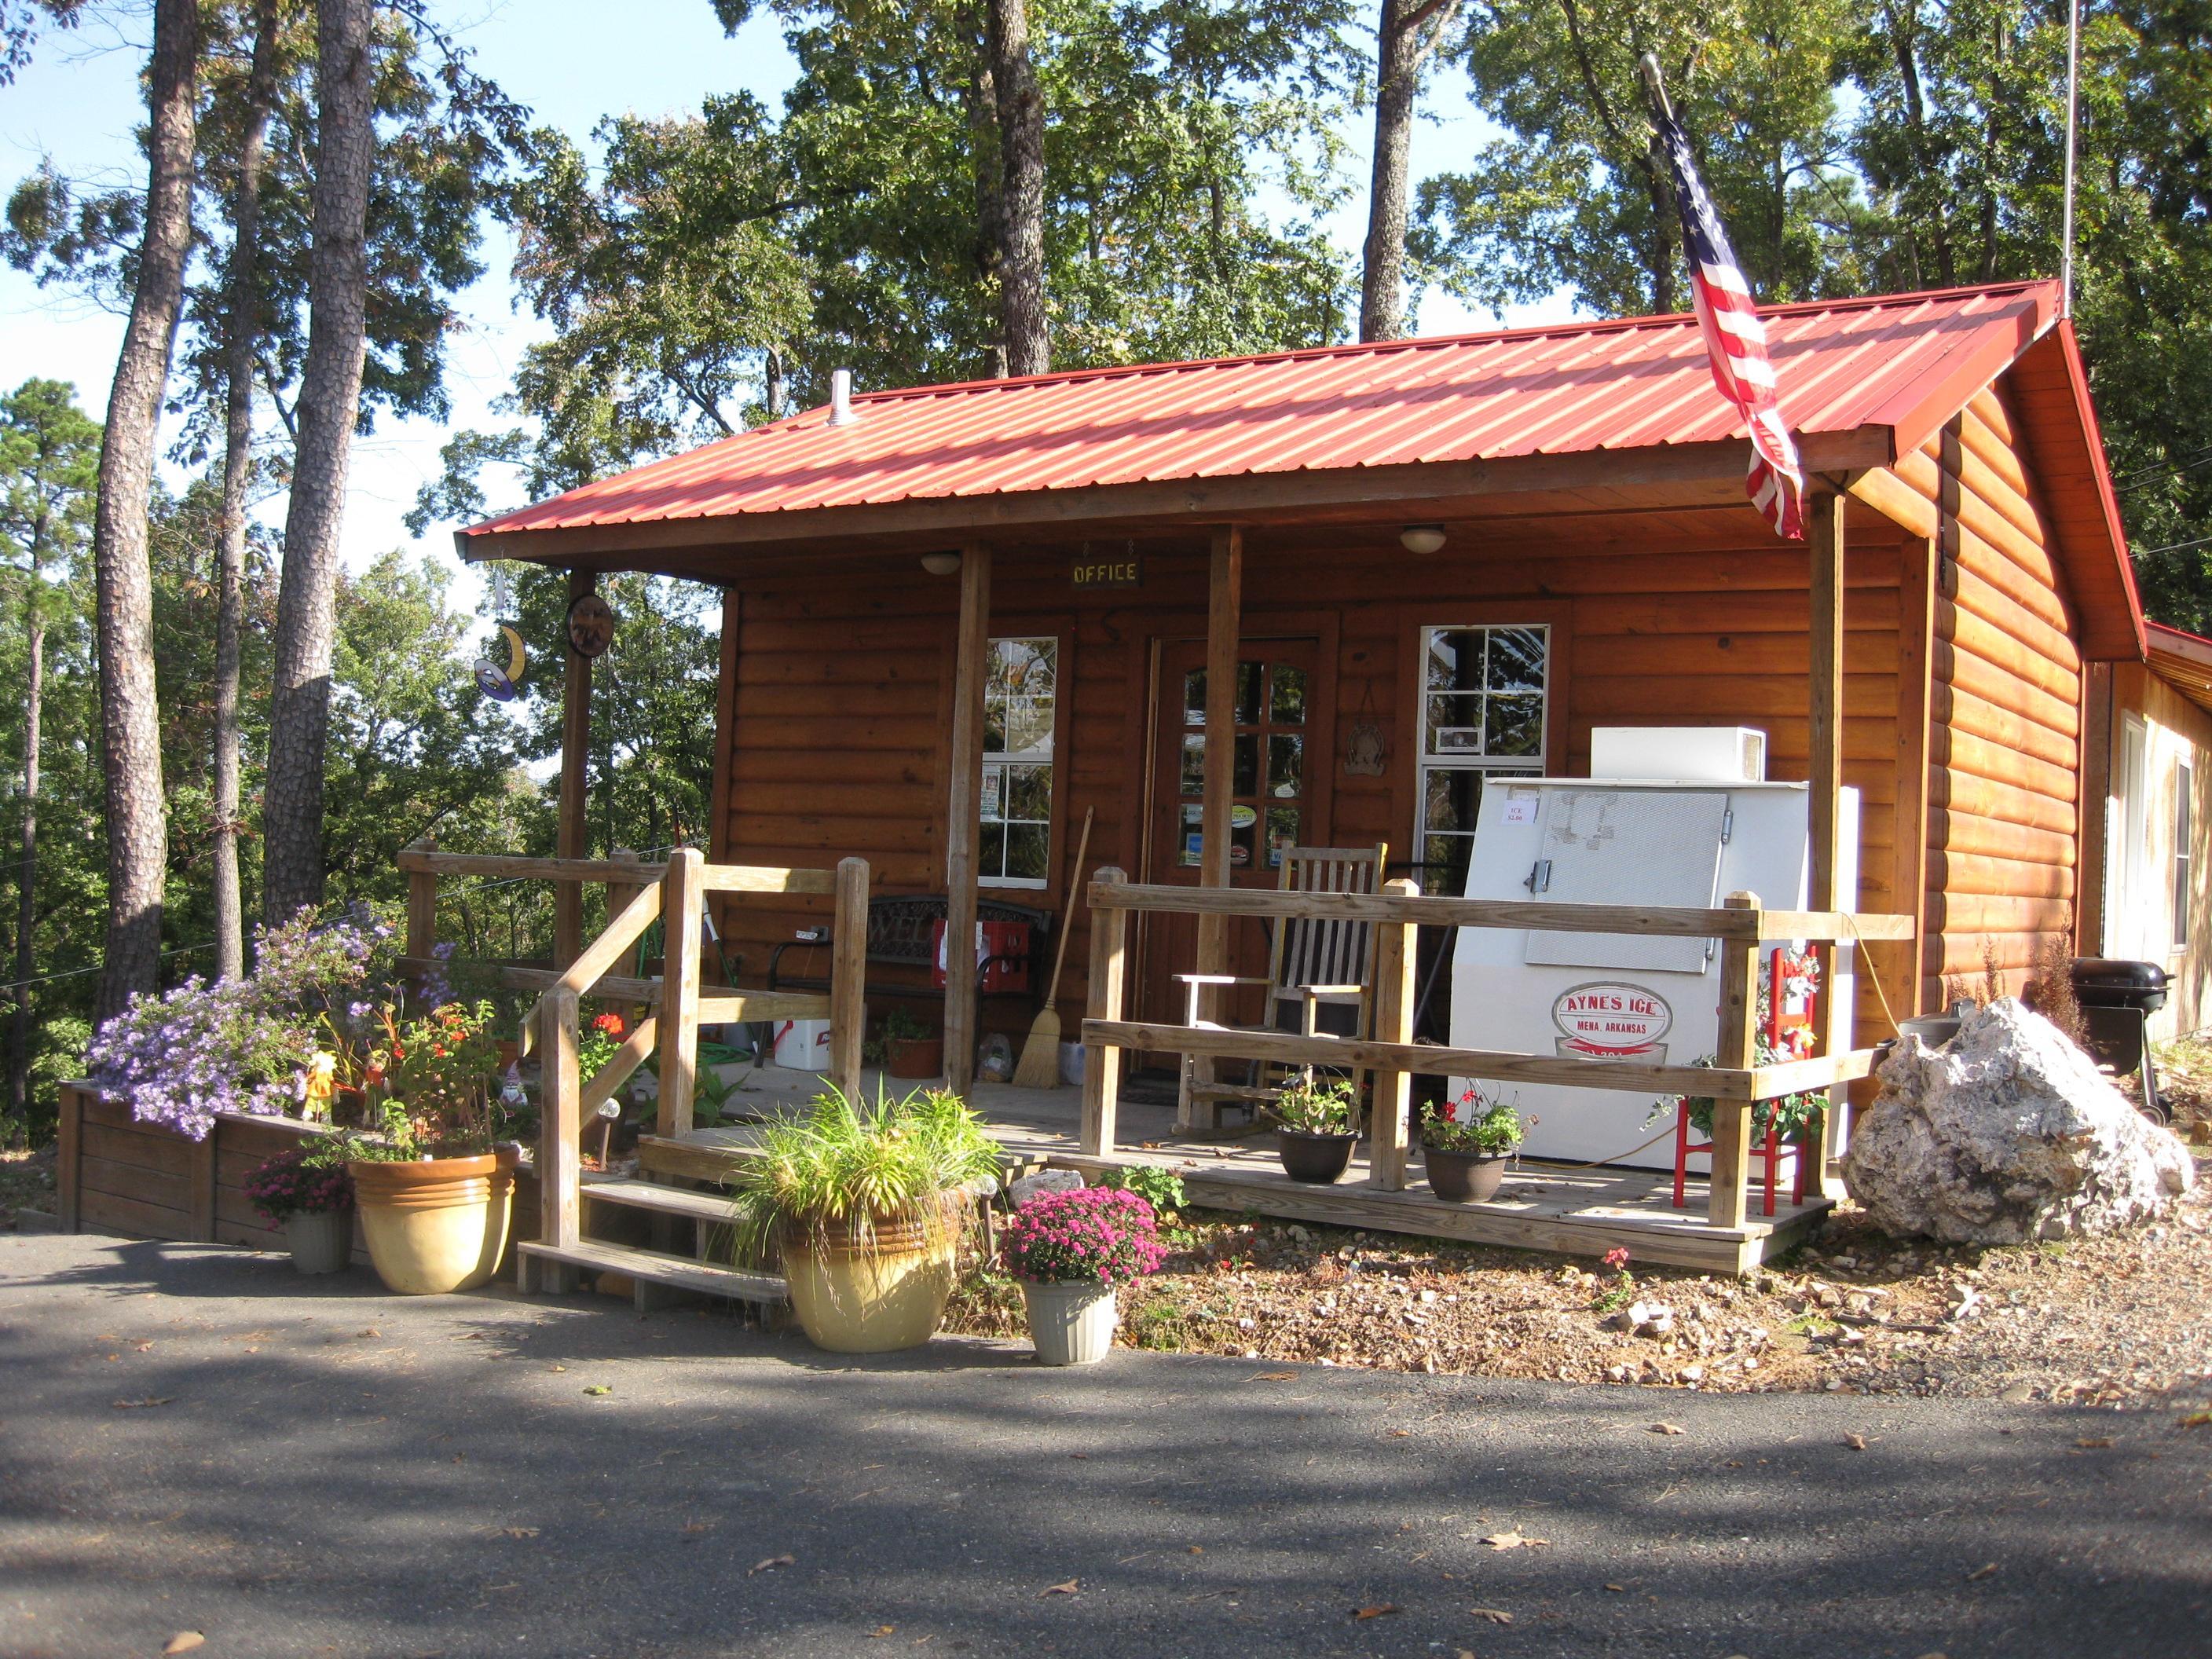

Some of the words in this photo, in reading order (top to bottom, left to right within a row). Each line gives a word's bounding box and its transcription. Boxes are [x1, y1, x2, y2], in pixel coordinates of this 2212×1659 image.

[1074, 563, 1136, 583] OFFICE
[1567, 994, 1623, 1011] AYNES
[1629, 996, 1658, 1015] ICE
[1605, 1022, 1646, 1035] ARKANSAS
